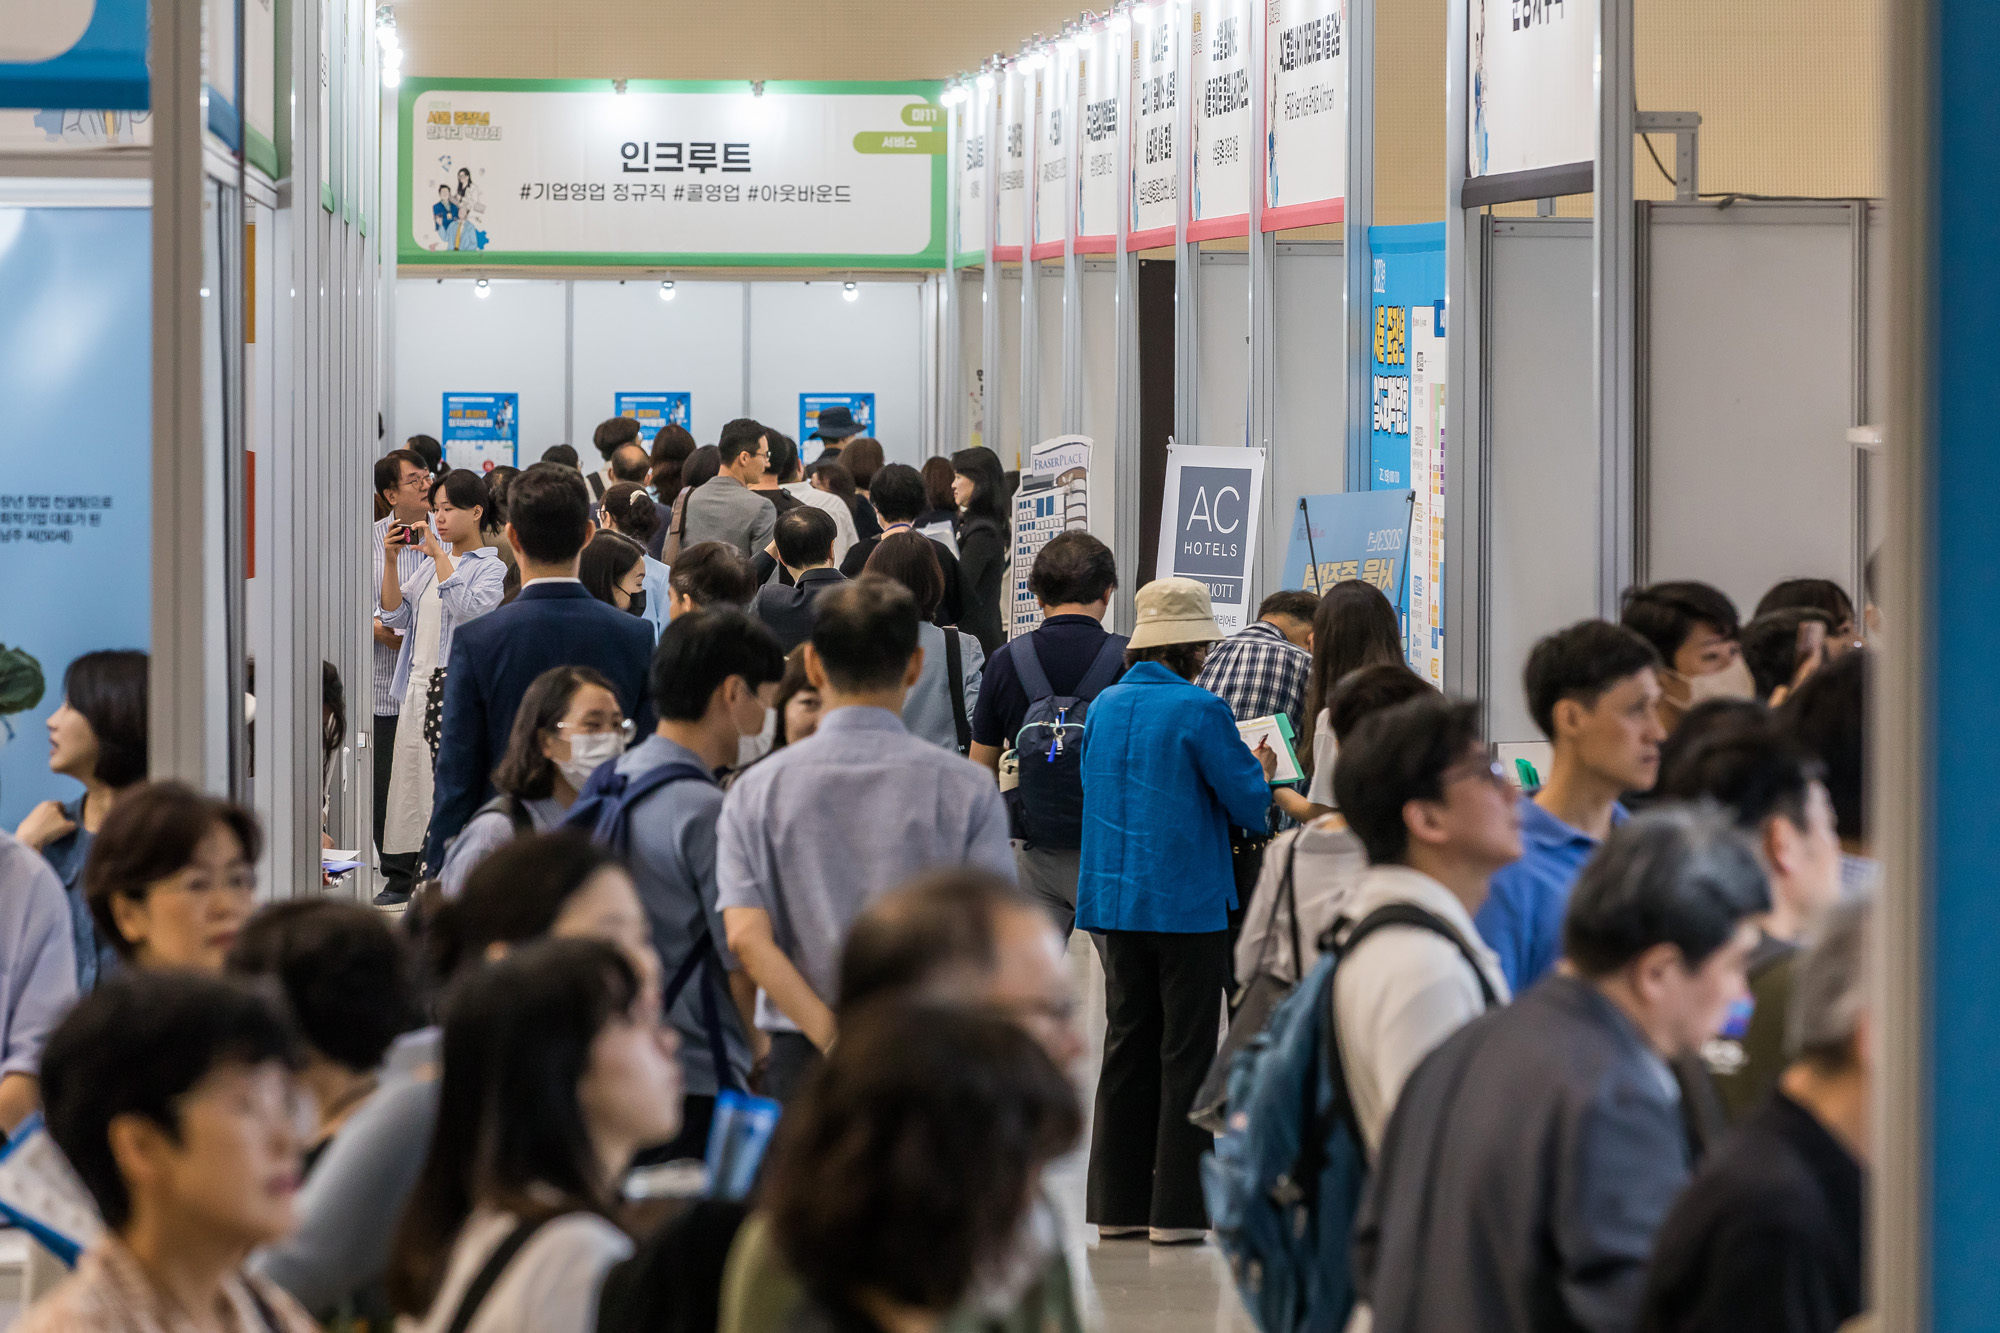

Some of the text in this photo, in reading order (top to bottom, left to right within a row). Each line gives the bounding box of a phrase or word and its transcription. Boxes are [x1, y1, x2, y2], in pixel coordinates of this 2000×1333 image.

[881, 135, 917, 148] 서비스
[620, 141, 751, 174] 인크루트
[520, 182, 851, 203] #기업영업 정규직 #콜영업 #아웃바운드
[1186, 485, 1240, 534] AC
[1184, 541, 1238, 557] HOTELS
